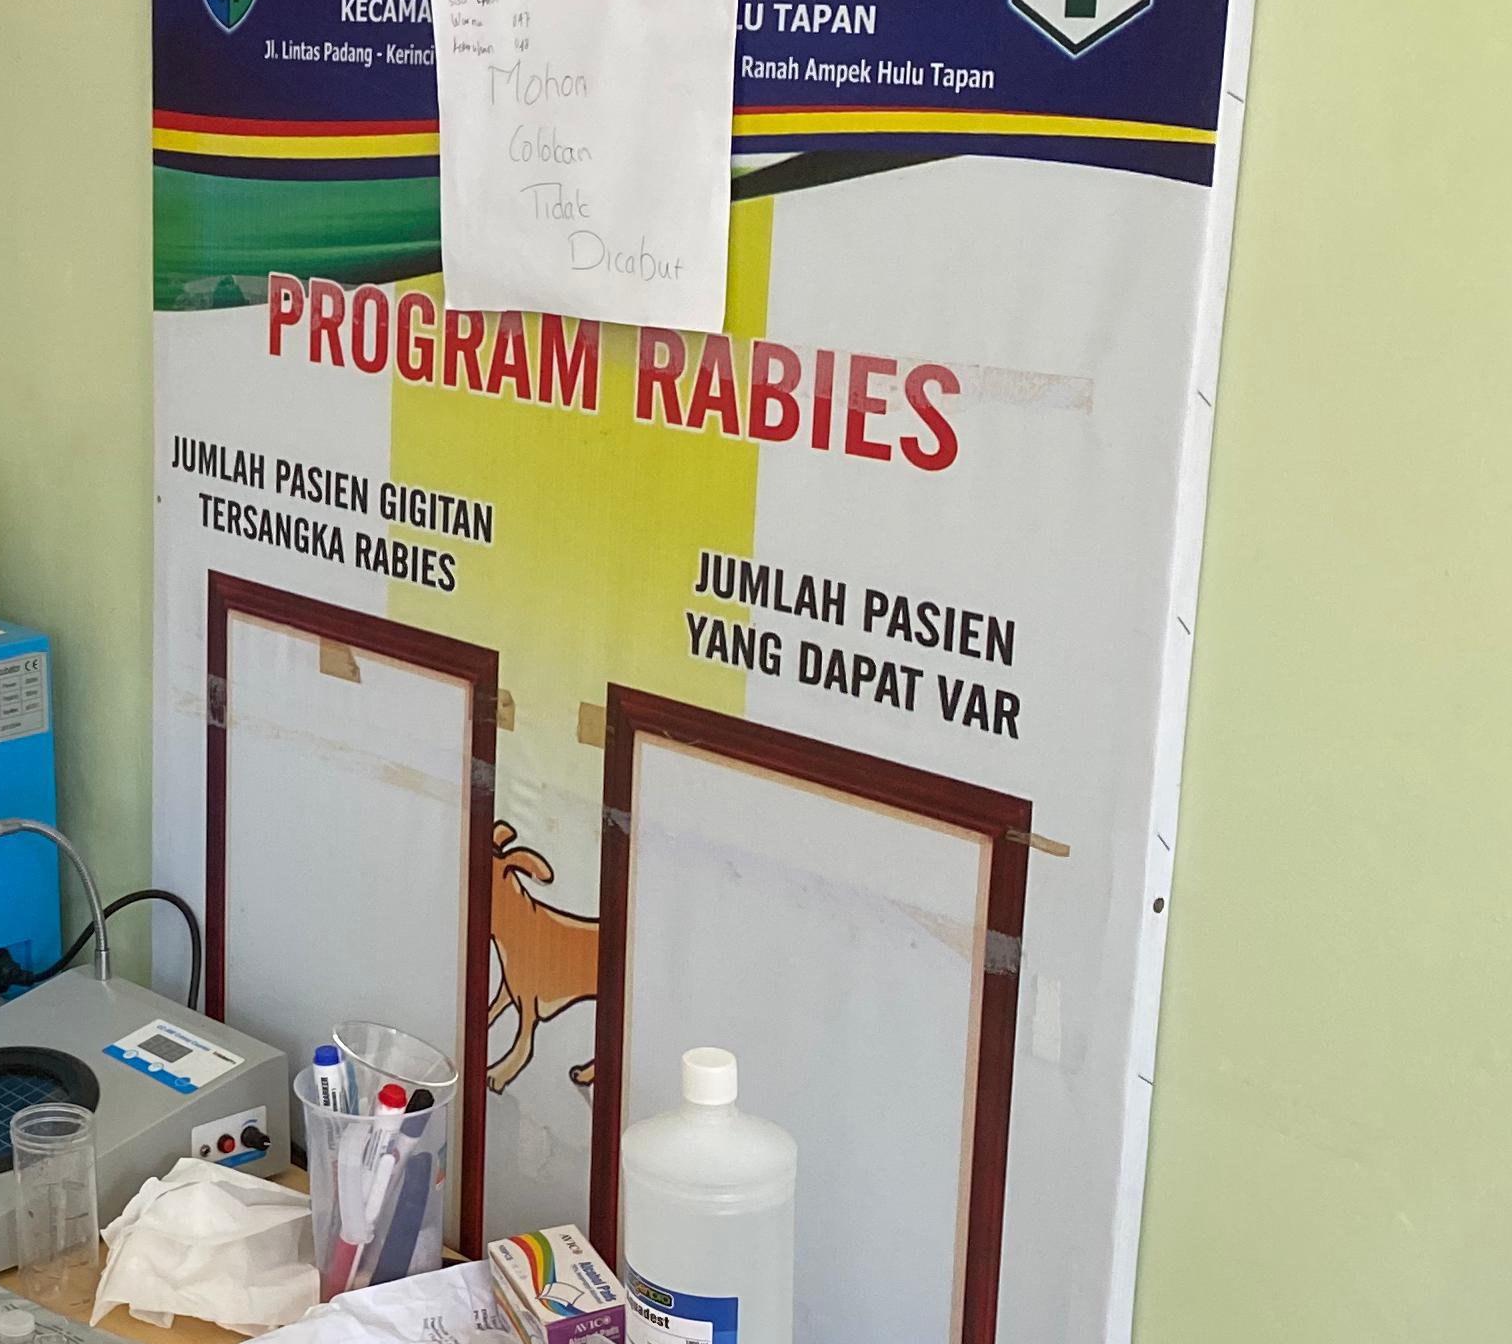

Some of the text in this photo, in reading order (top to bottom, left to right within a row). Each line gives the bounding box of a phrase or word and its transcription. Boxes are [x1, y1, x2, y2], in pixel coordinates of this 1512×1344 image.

[773, 3, 876, 35] TAPAN
[265, 40, 278, 59] Jl.
[282, 40, 320, 60] Lintas
[324, 41, 373, 67] Padang
[386, 45, 434, 65] Kerinci
[742, 55, 994, 93] Ranah Ampek Hulu Tapan
[487, 60, 588, 106] Mohon
[568, 230, 684, 282] Dicabut
[266, 267, 960, 472] PROGRAM RABIES
[171, 433, 495, 544] JUMLAH PASIEN GIGITAN
[198, 491, 458, 593] TERSANGKA RABIES
[693, 551, 1016, 667] JUMLAH PASIEN
[684, 610, 1022, 740] YANG DAPAT VAR
[321, 1077, 330, 1106] MARKER
